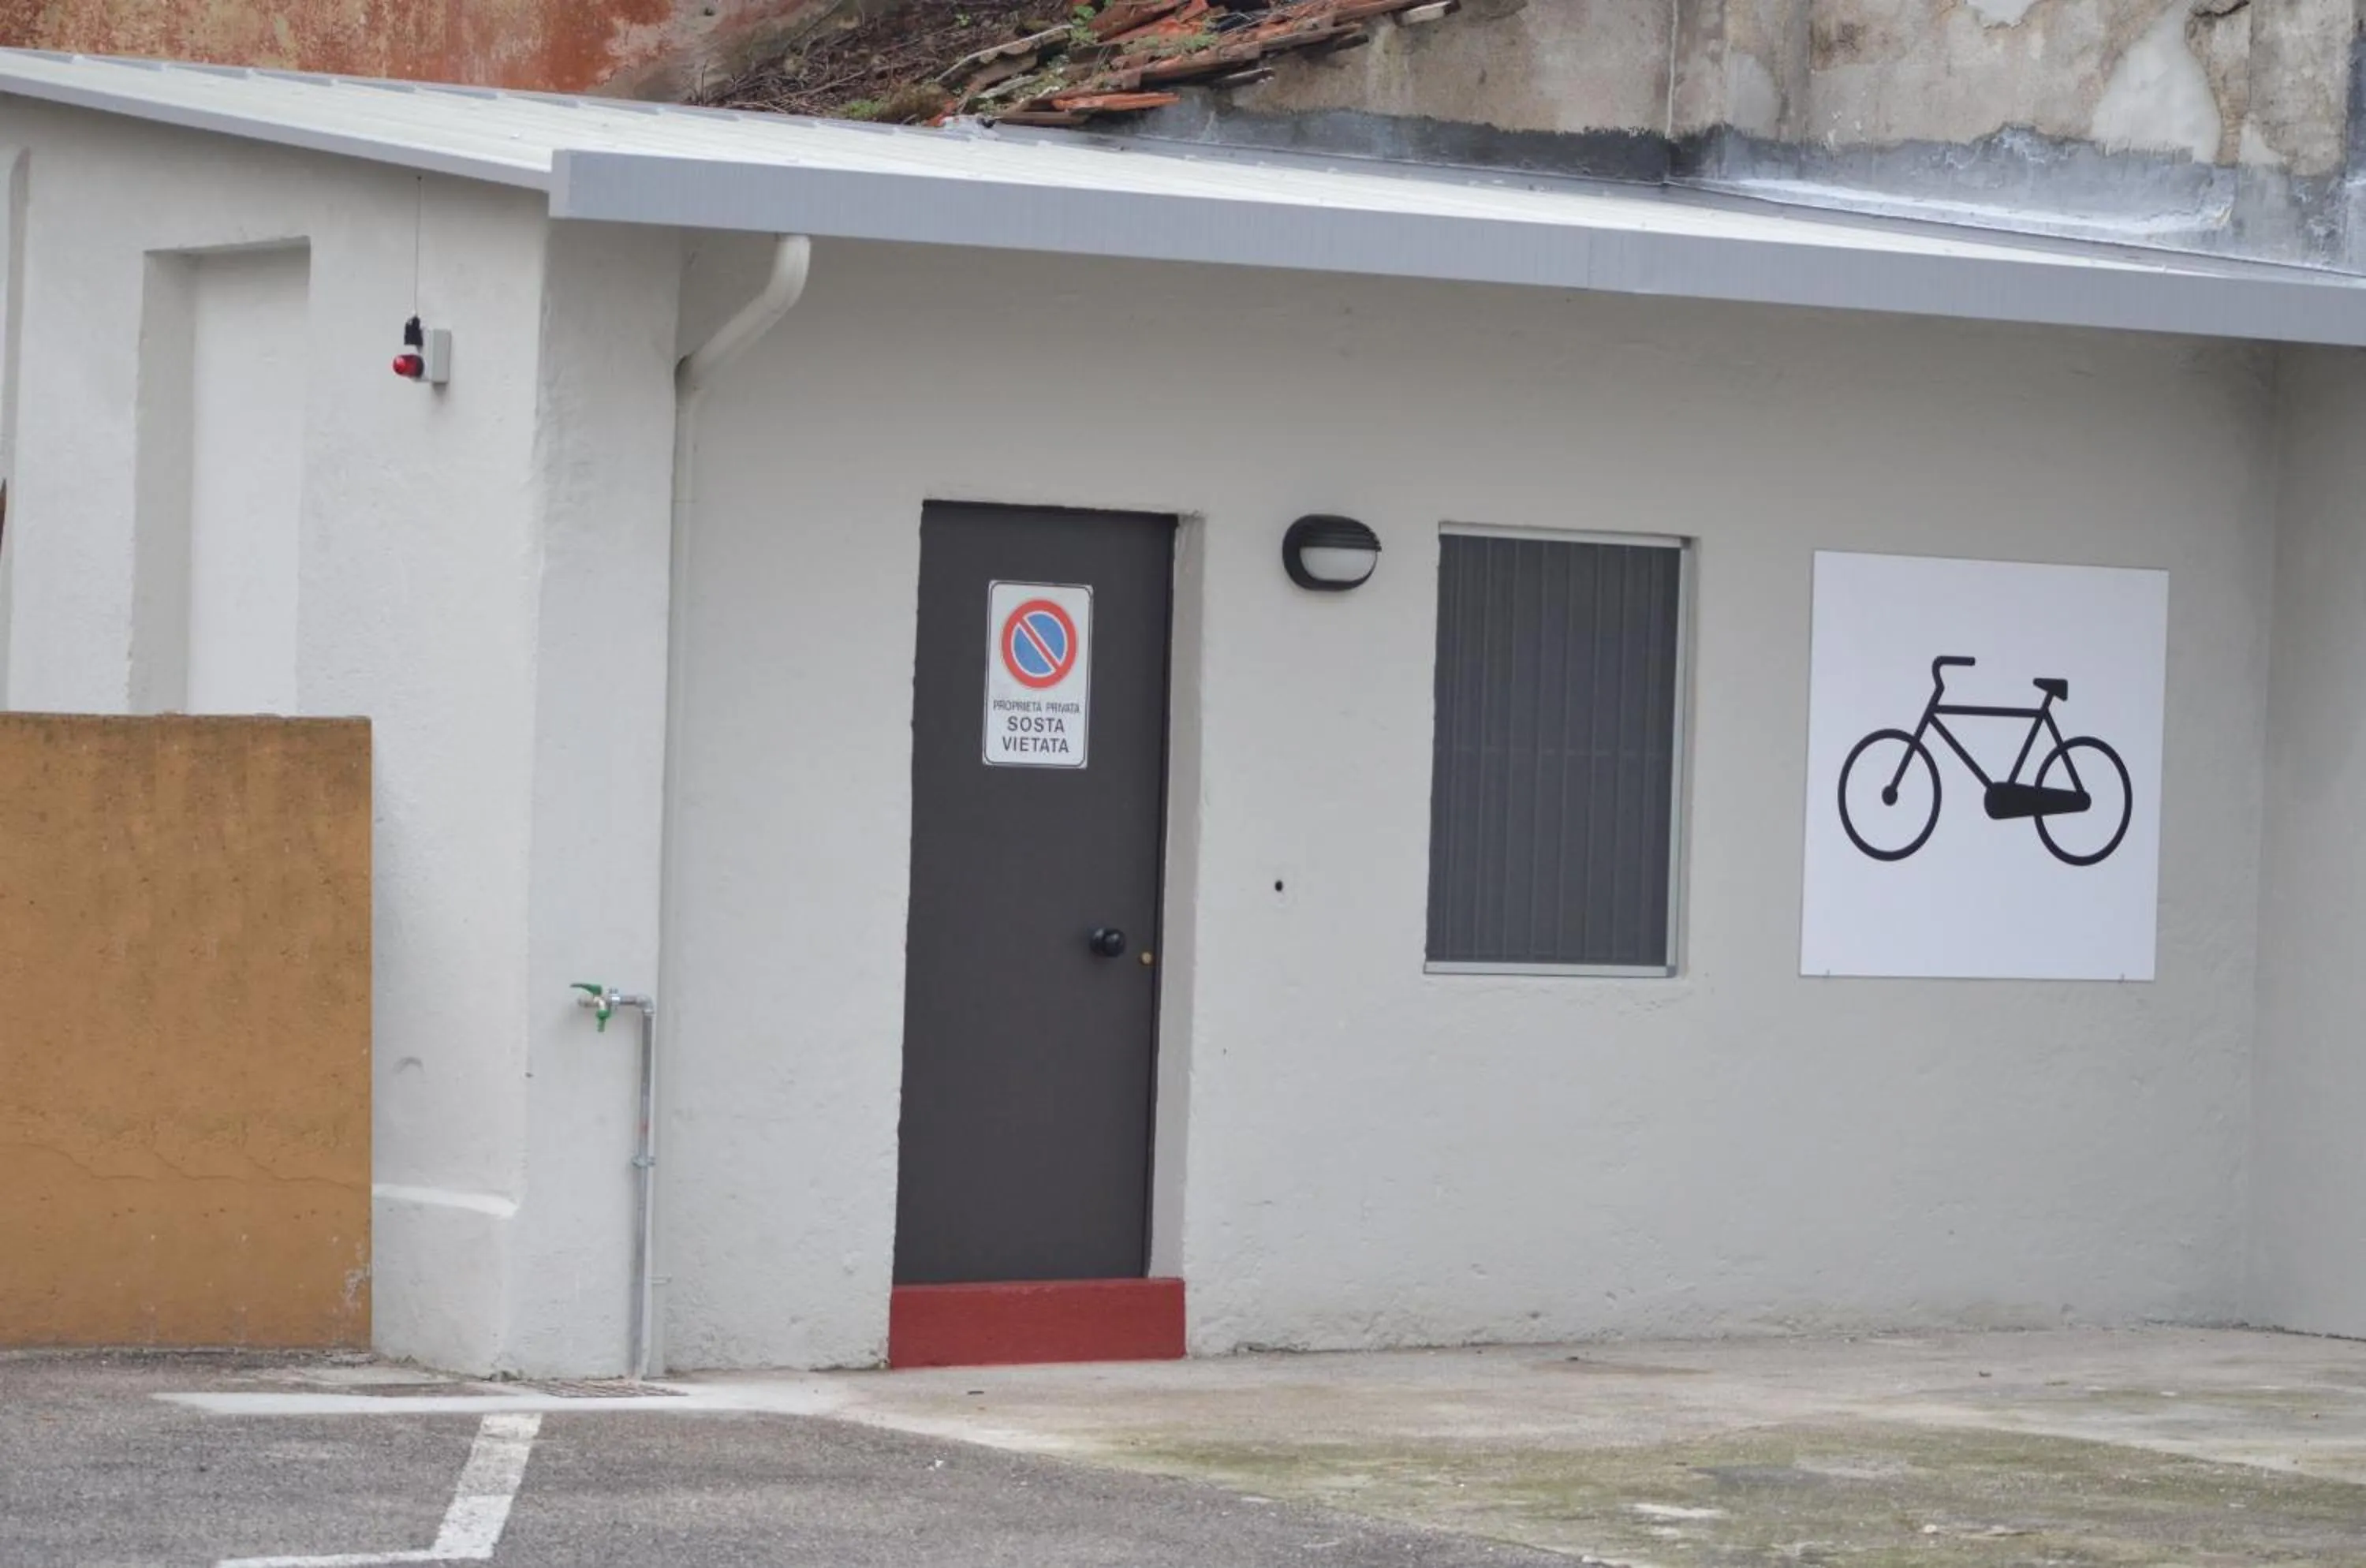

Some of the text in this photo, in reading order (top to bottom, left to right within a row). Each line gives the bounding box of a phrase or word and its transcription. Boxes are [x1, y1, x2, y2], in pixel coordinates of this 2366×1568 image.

[1046, 702, 1080, 714] PRIVATA
[1007, 715, 1065, 733] SOSTA
[1002, 736, 1069, 753] VIETATA
